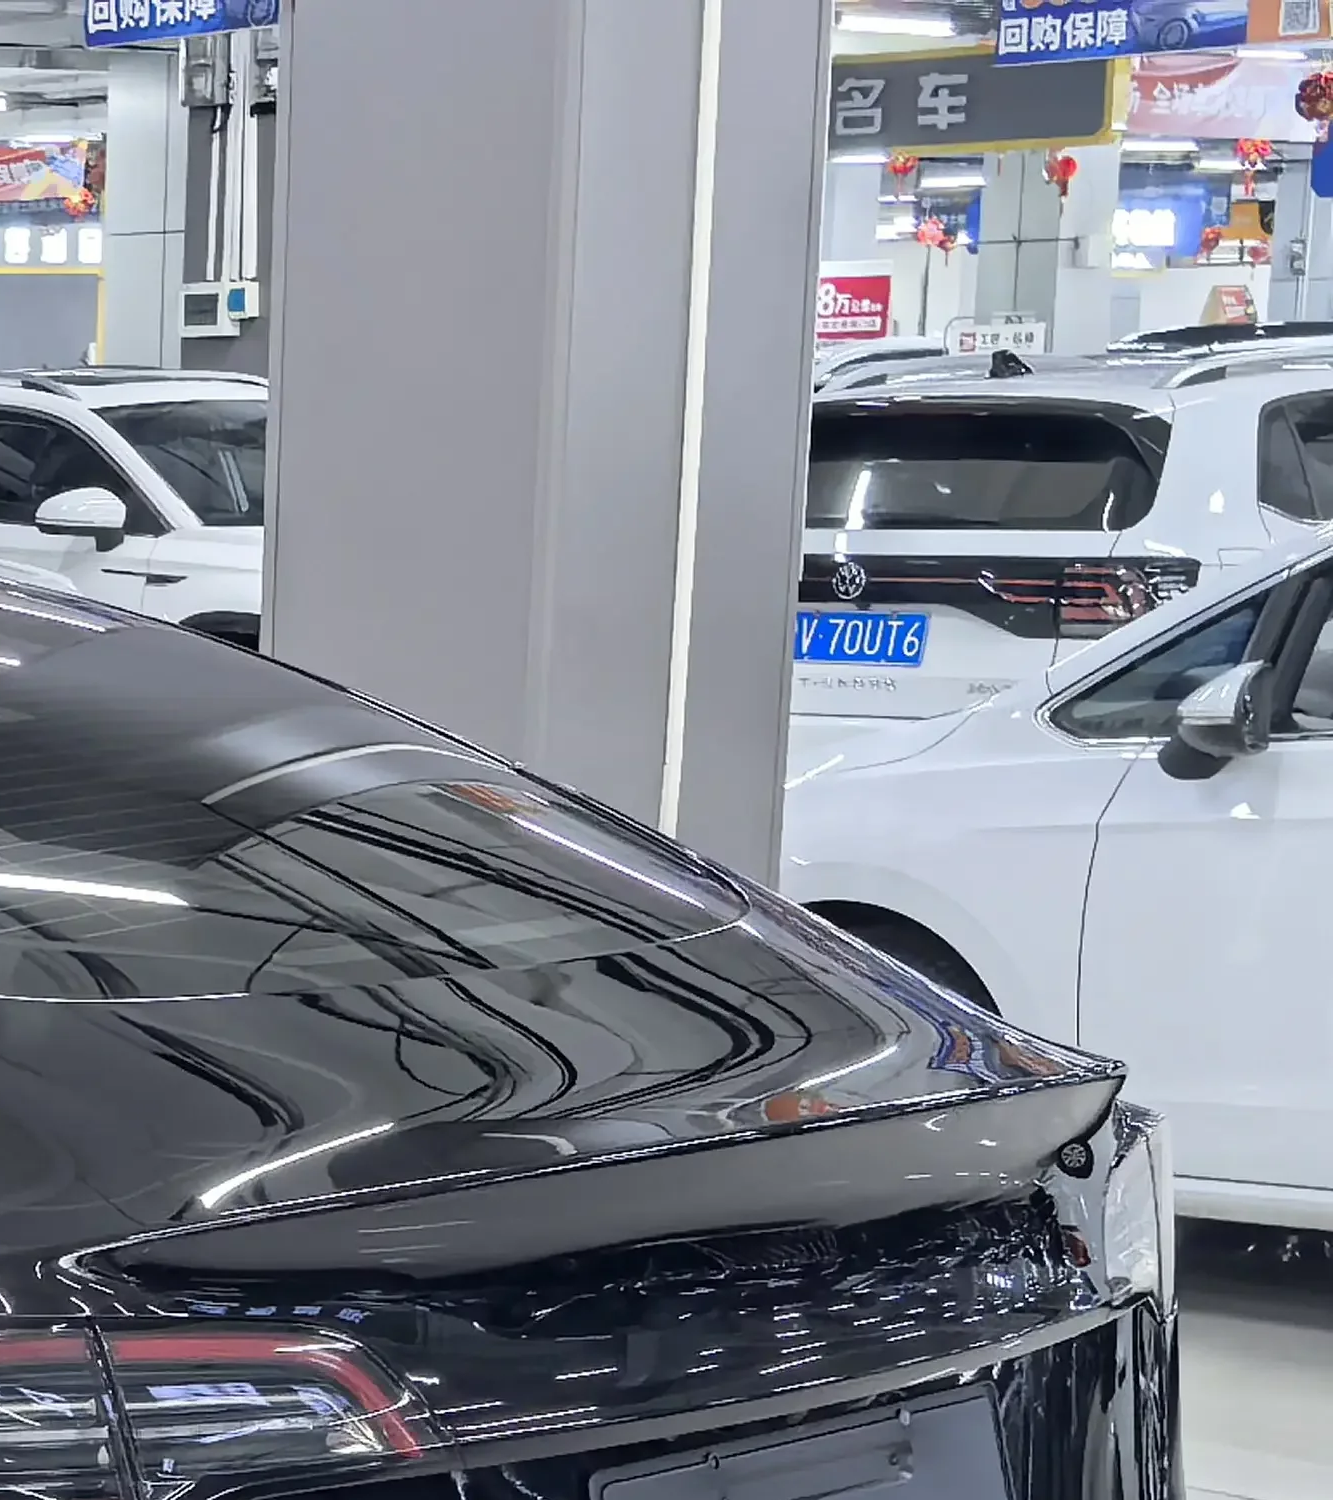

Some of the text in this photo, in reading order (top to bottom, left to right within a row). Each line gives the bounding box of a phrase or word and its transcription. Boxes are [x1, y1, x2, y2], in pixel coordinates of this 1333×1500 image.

[999, 8, 1129, 55] 回购保障
[835, 72, 969, 135] 名车
